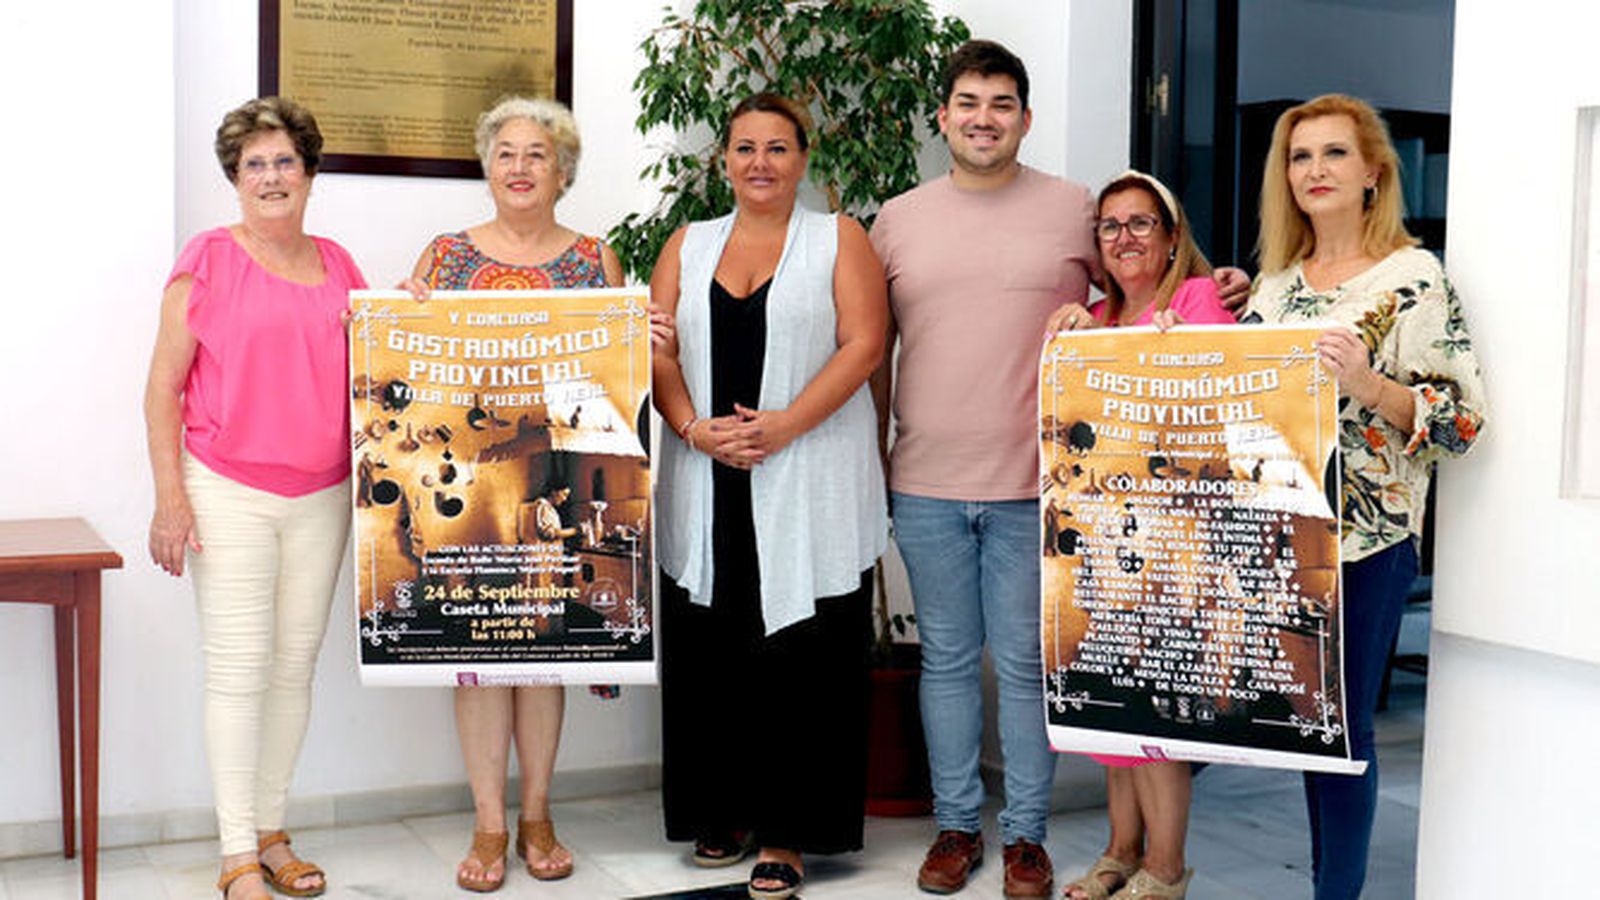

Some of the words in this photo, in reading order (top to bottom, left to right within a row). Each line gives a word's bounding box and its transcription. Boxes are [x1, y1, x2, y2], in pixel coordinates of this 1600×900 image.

[466, 311, 549, 327] CONCURSO
[387, 326, 610, 361] GASTRONÓMICO
[1151, 352, 1226, 368] CONCURSO
[408, 358, 593, 387] PROVINCIAL
[1085, 367, 1280, 401] GASTRONÓMICO
[391, 385, 443, 404] VILLA
[454, 393, 474, 408] DE
[483, 392, 555, 409] PUERTO
[1102, 398, 1265, 427] PROVINCIAL
[1091, 422, 1132, 441] VILLA
[1139, 430, 1160, 445] DE
[1166, 429, 1227, 446] PUERTO
[1106, 476, 1258, 497] COLABORADORES
[1194, 498, 1208, 508] LA
[1232, 511, 1279, 522] NATALIA
[1282, 524, 1294, 534] EL
[1215, 544, 1228, 553] TU
[1232, 545, 1260, 556] PELO
[1282, 547, 1295, 557] EL
[424, 585, 447, 600] 24
[451, 584, 474, 600] de
[479, 582, 581, 605] Septiembre
[440, 602, 490, 615] Caseta
[492, 600, 566, 618] Municipal
[1134, 603, 1197, 617] CARNICERÍA
[471, 618, 479, 627] a
[481, 616, 517, 630] partir
[520, 615, 536, 628] de
[1192, 619, 1213, 630] BAR
[1216, 621, 1229, 631] EL
[472, 628, 490, 640] las
[493, 629, 524, 640] 11:00
[527, 628, 536, 640] h
[1085, 631, 1141, 646] PLATANITO
[1161, 638, 1226, 653] CARNICERÍA
[1229, 645, 1242, 655] EL
[1088, 621, 1140, 635] CALLEJÓN
[1142, 626, 1160, 636] DEL
[1163, 628, 1191, 639] VINO
[1269, 638, 1281, 648] EL
[1078, 641, 1141, 656] PELUQUERÍA
[1144, 648, 1183, 660] NACHO
[1204, 652, 1218, 664] LA
[1080, 652, 1119, 665] MUELLE
[1140, 658, 1161, 669] BAR
[1163, 660, 1176, 670] EL
[1133, 667, 1171, 681] MESÓN
[1173, 672, 1188, 683] LA
[1190, 674, 1225, 687] PLAZA
[1246, 679, 1277, 693] CASA
[1278, 682, 1306, 696] JOSÉ
[1155, 680, 1169, 691] DE
[1172, 682, 1204, 695] TODO
[1206, 686, 1223, 697] UN
[1225, 687, 1259, 701] POCO
